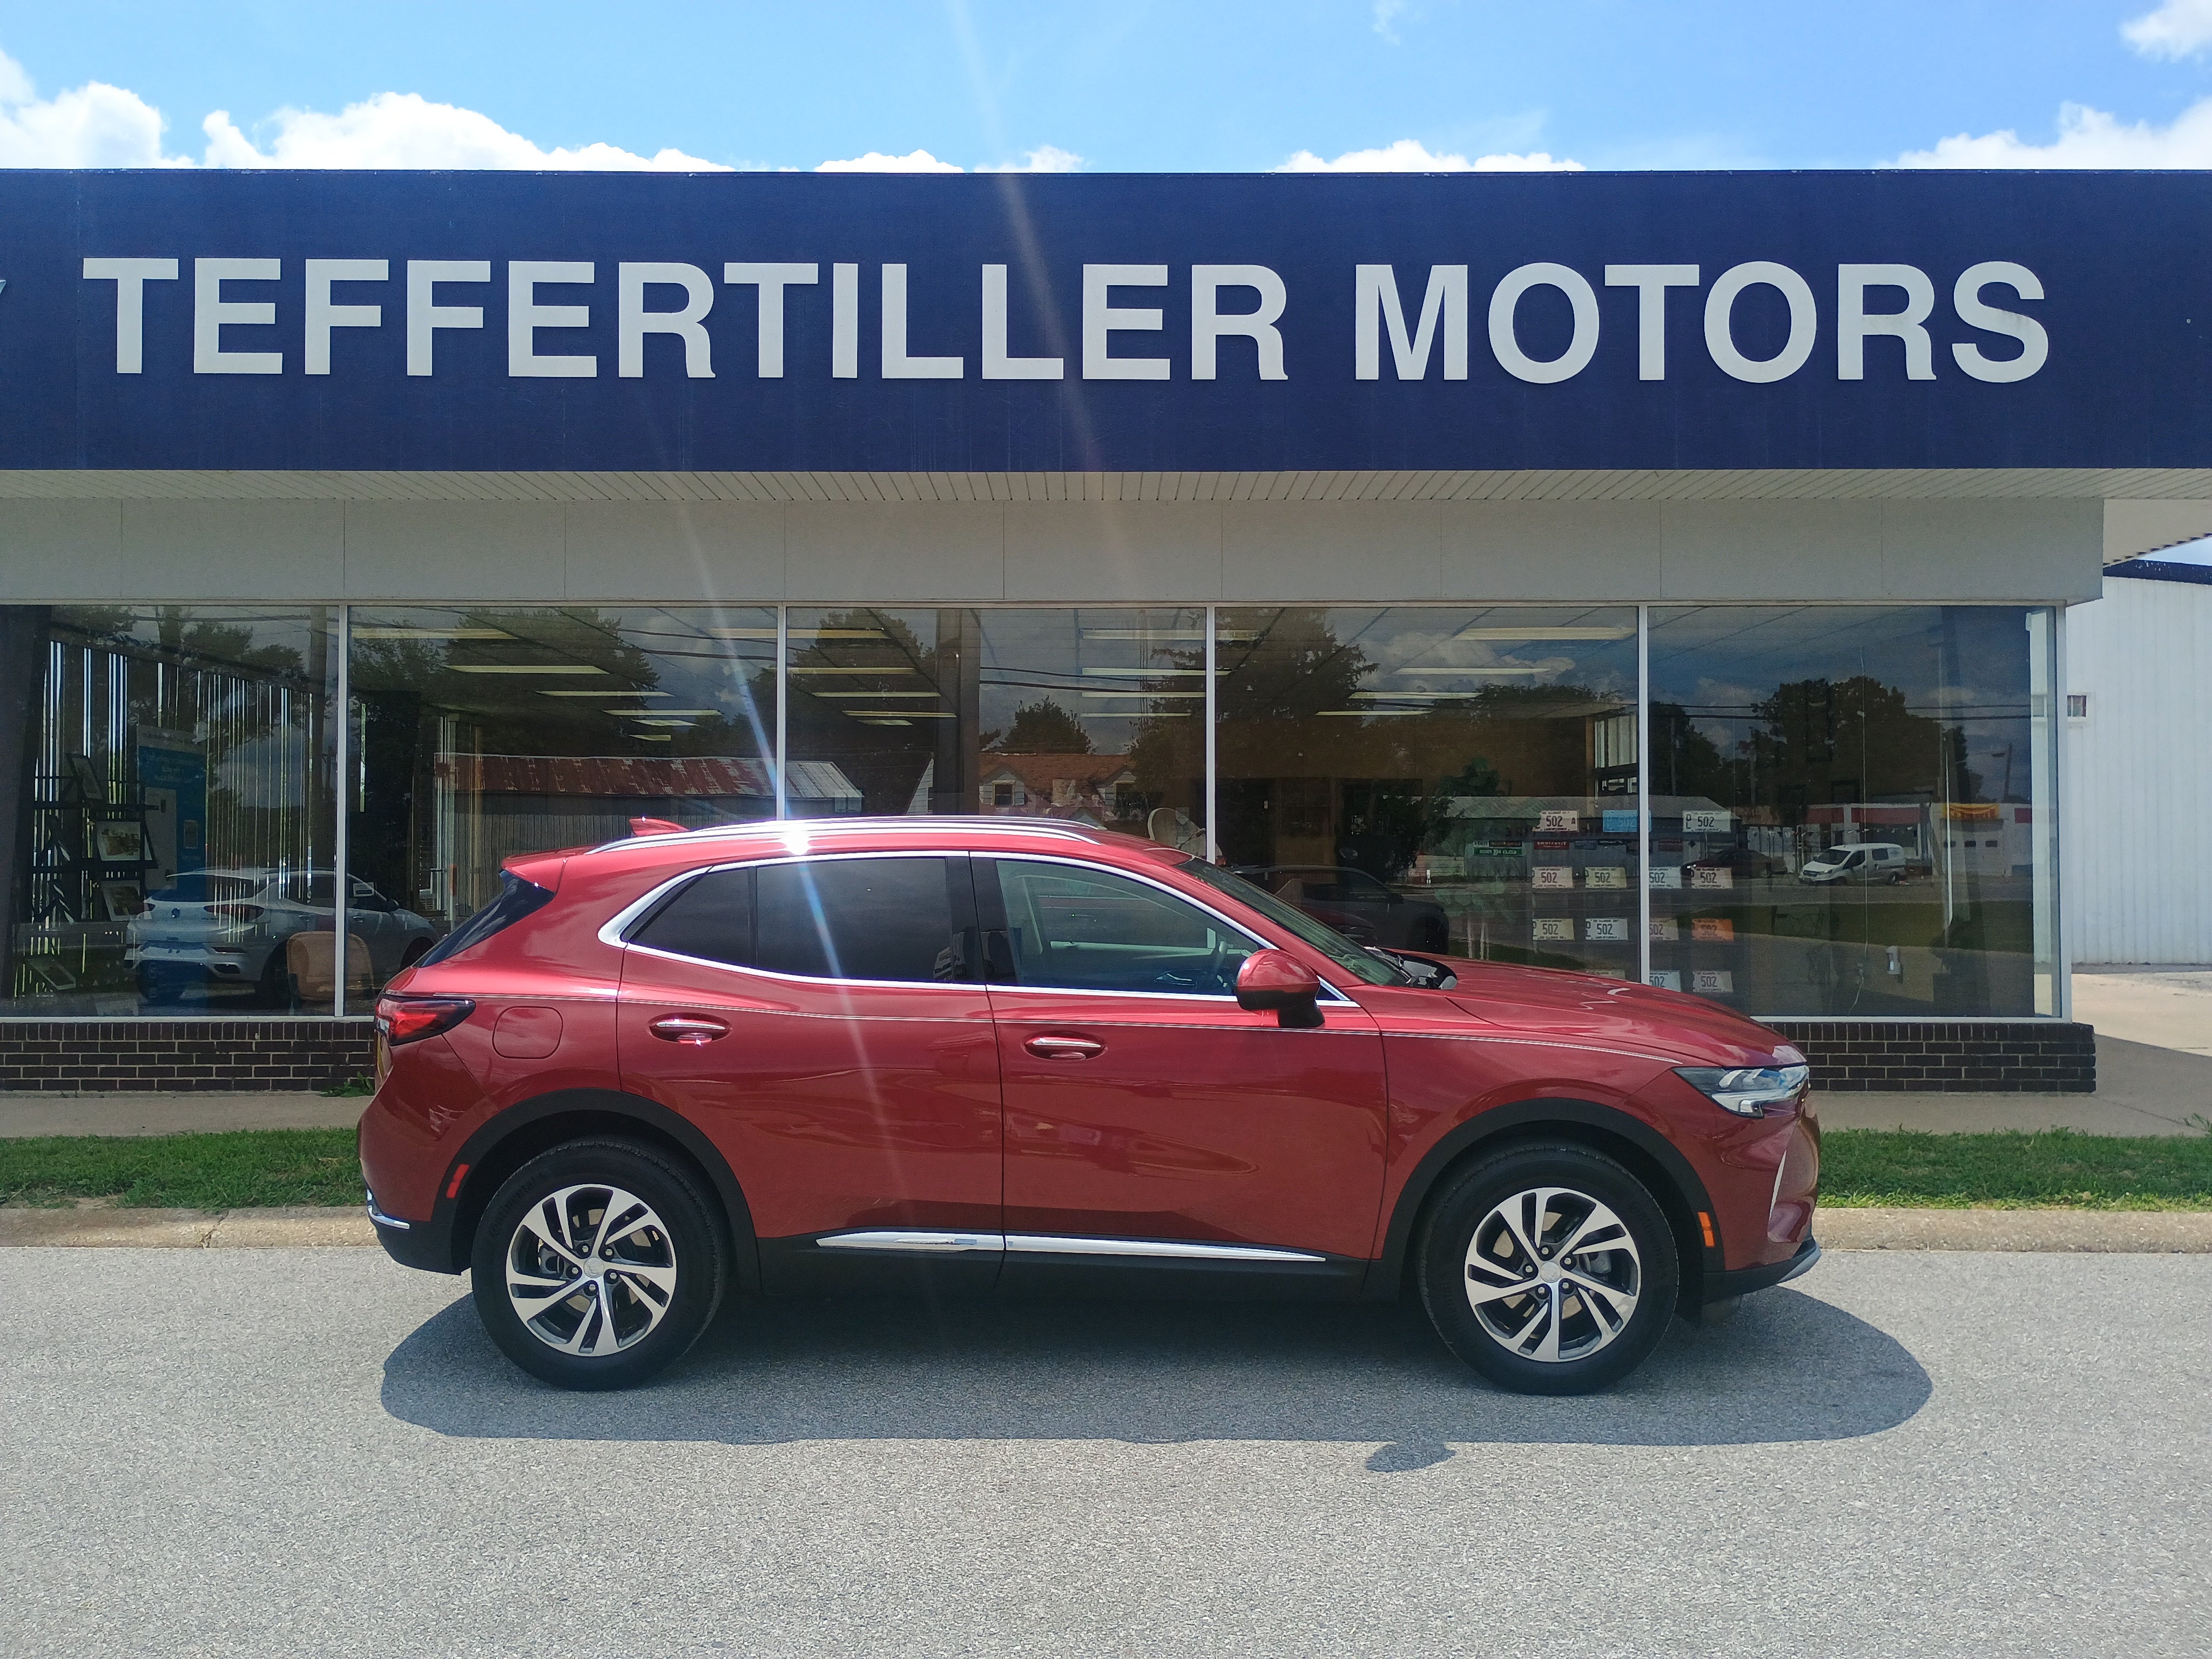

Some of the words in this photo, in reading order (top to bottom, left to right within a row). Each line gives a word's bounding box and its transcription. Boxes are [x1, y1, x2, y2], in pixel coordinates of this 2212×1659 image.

[83, 258, 1288, 381] TEFFERTILLER
[1355, 261, 2048, 384] MOTORS
[1546, 815, 1563, 827] 502
[1697, 816, 1715, 827] 502
[1541, 872, 1557, 884] 502
[1595, 872, 1611, 884] 502
[1649, 872, 1665, 884] 502
[1700, 872, 1717, 884] 502
[1542, 923, 1559, 935] 502
[1596, 923, 1614, 935] 502
[1701, 975, 1718, 988] 502
